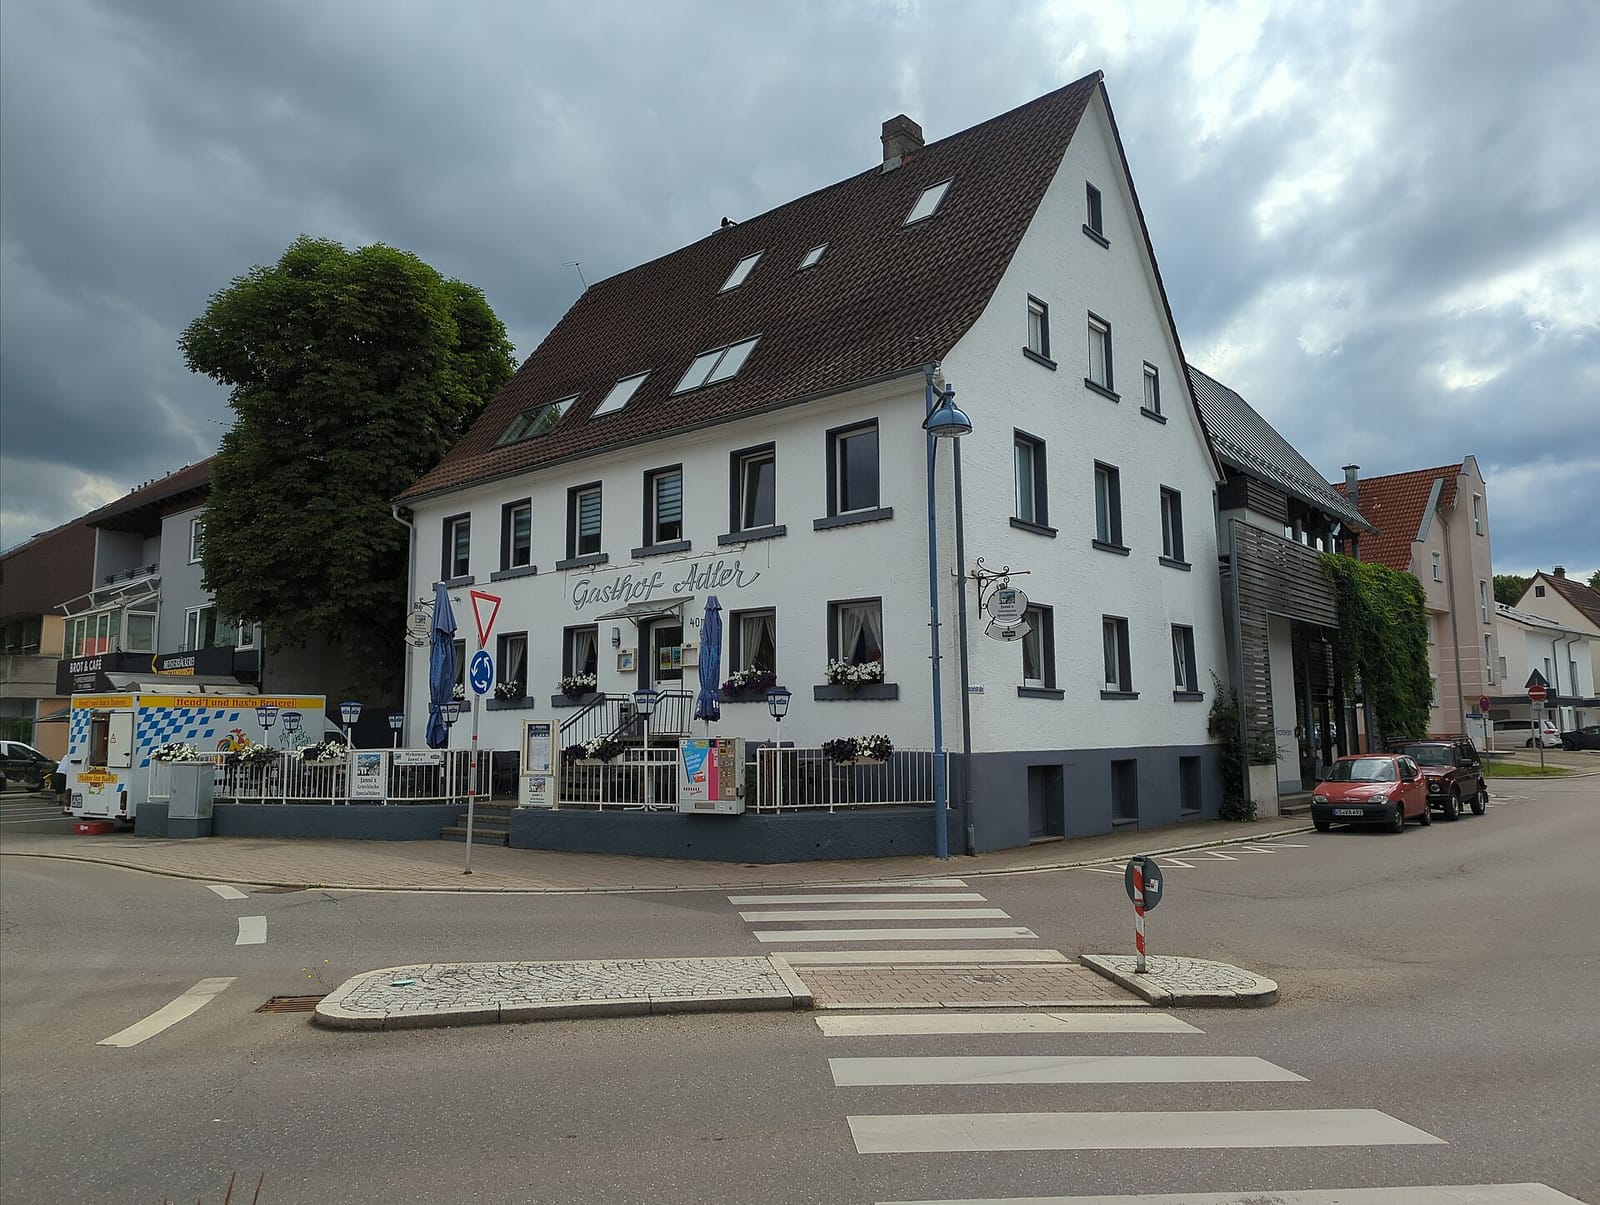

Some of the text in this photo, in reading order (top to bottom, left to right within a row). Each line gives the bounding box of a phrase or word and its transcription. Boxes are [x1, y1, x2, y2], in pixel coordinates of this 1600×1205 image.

[572, 560, 760, 610] Gasthof Adler
[690, 617, 700, 628] 40
[69, 656, 102, 673] BROT & CAFÉ
[211, 698, 229, 707] und
[261, 699, 294, 708] Braterei
